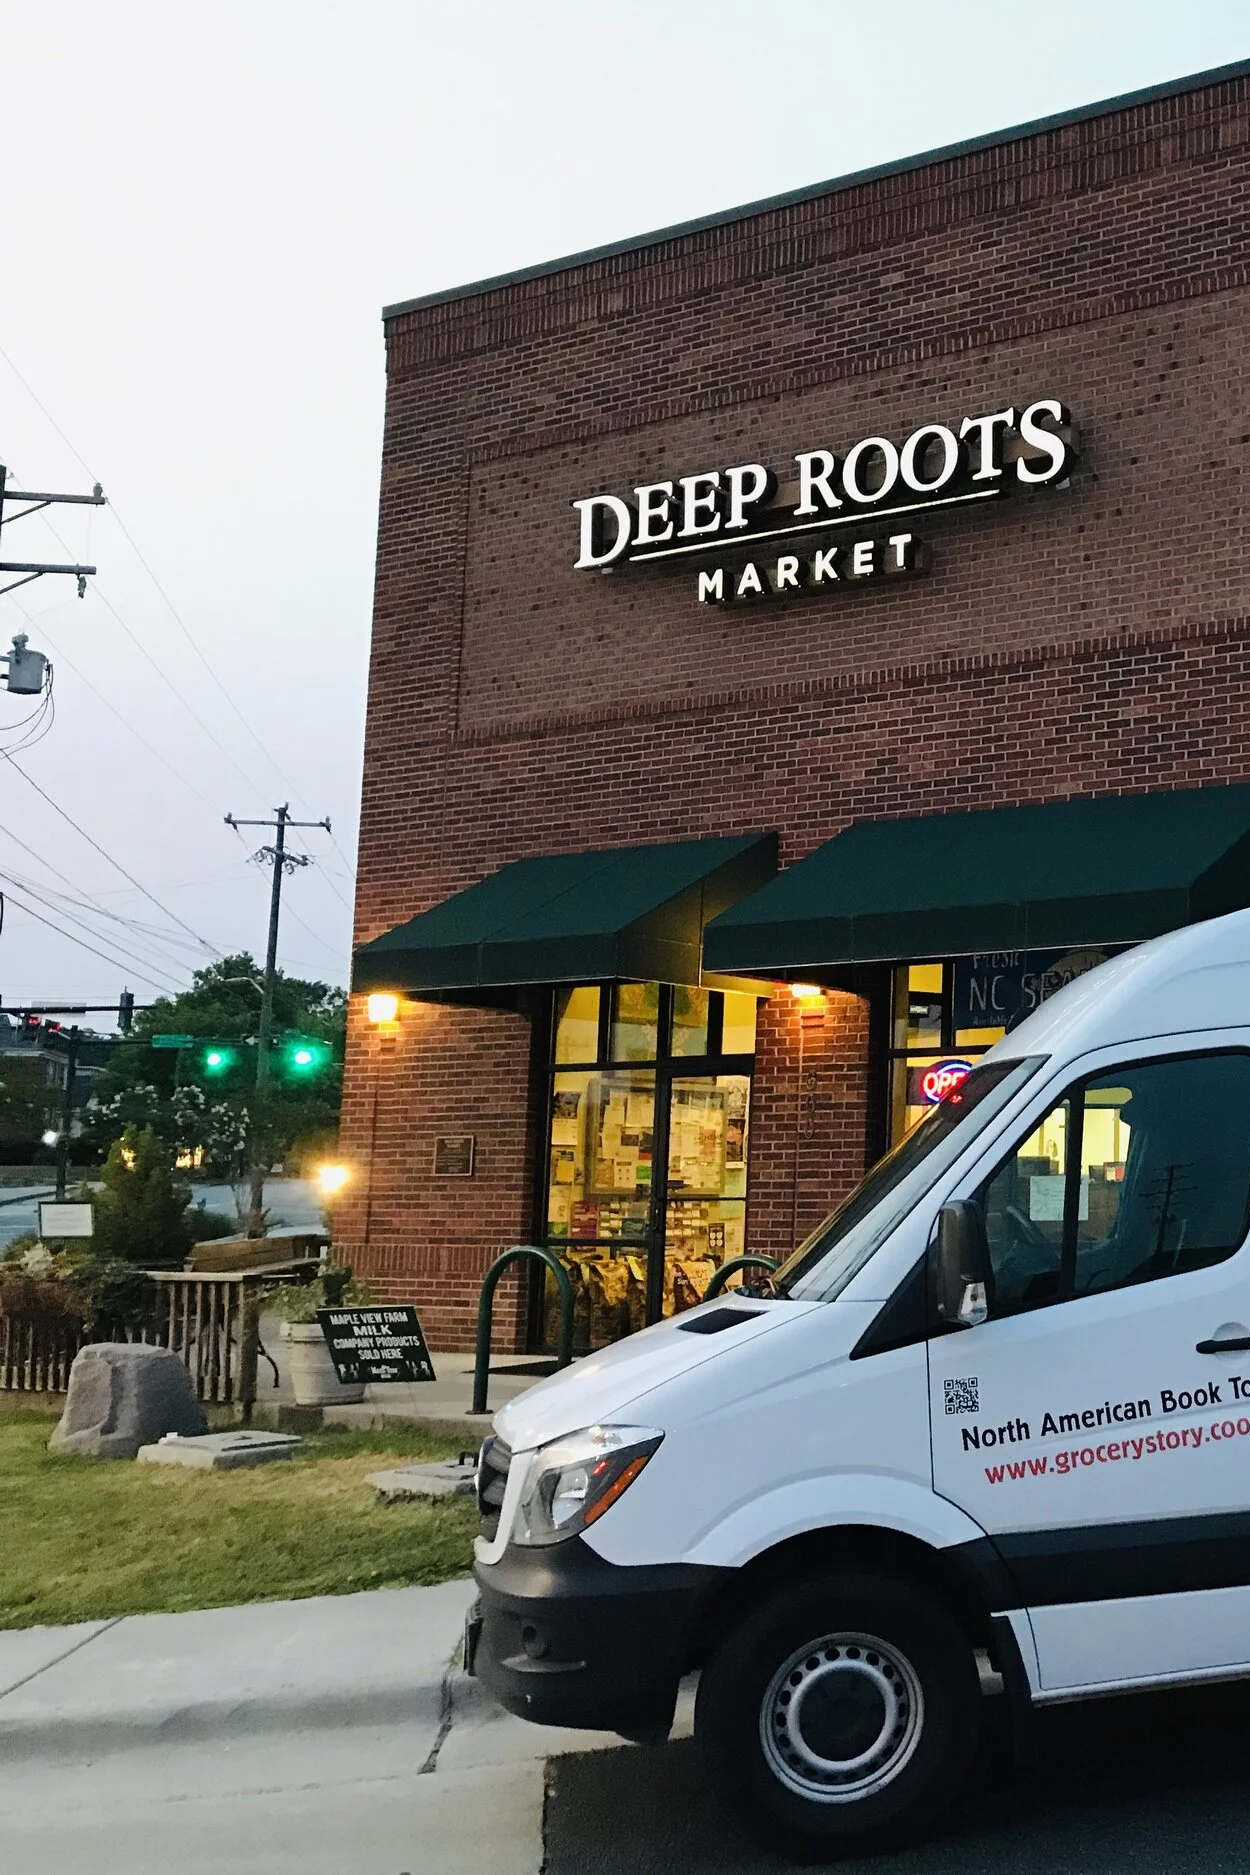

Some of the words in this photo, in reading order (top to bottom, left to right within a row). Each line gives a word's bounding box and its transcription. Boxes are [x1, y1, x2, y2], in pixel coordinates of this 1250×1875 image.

[572, 462, 767, 569] DEEP
[793, 399, 1067, 516] ROOTS
[697, 533, 912, 601] MARKET
[969, 975, 1007, 1012] NC
[329, 1314, 360, 1325] MAPLE
[360, 1312, 383, 1324] VIEW
[383, 1311, 408, 1323] FARM
[352, 1324, 392, 1336] MILK
[333, 1337, 374, 1349] COMPANY
[375, 1335, 420, 1347] PRODUCTS
[357, 1349, 380, 1360] SOLD
[381, 1348, 404, 1360] HERE
[961, 1418, 1030, 1451] North
[1040, 1397, 1152, 1437] American
[1160, 1381, 1222, 1413] Book
